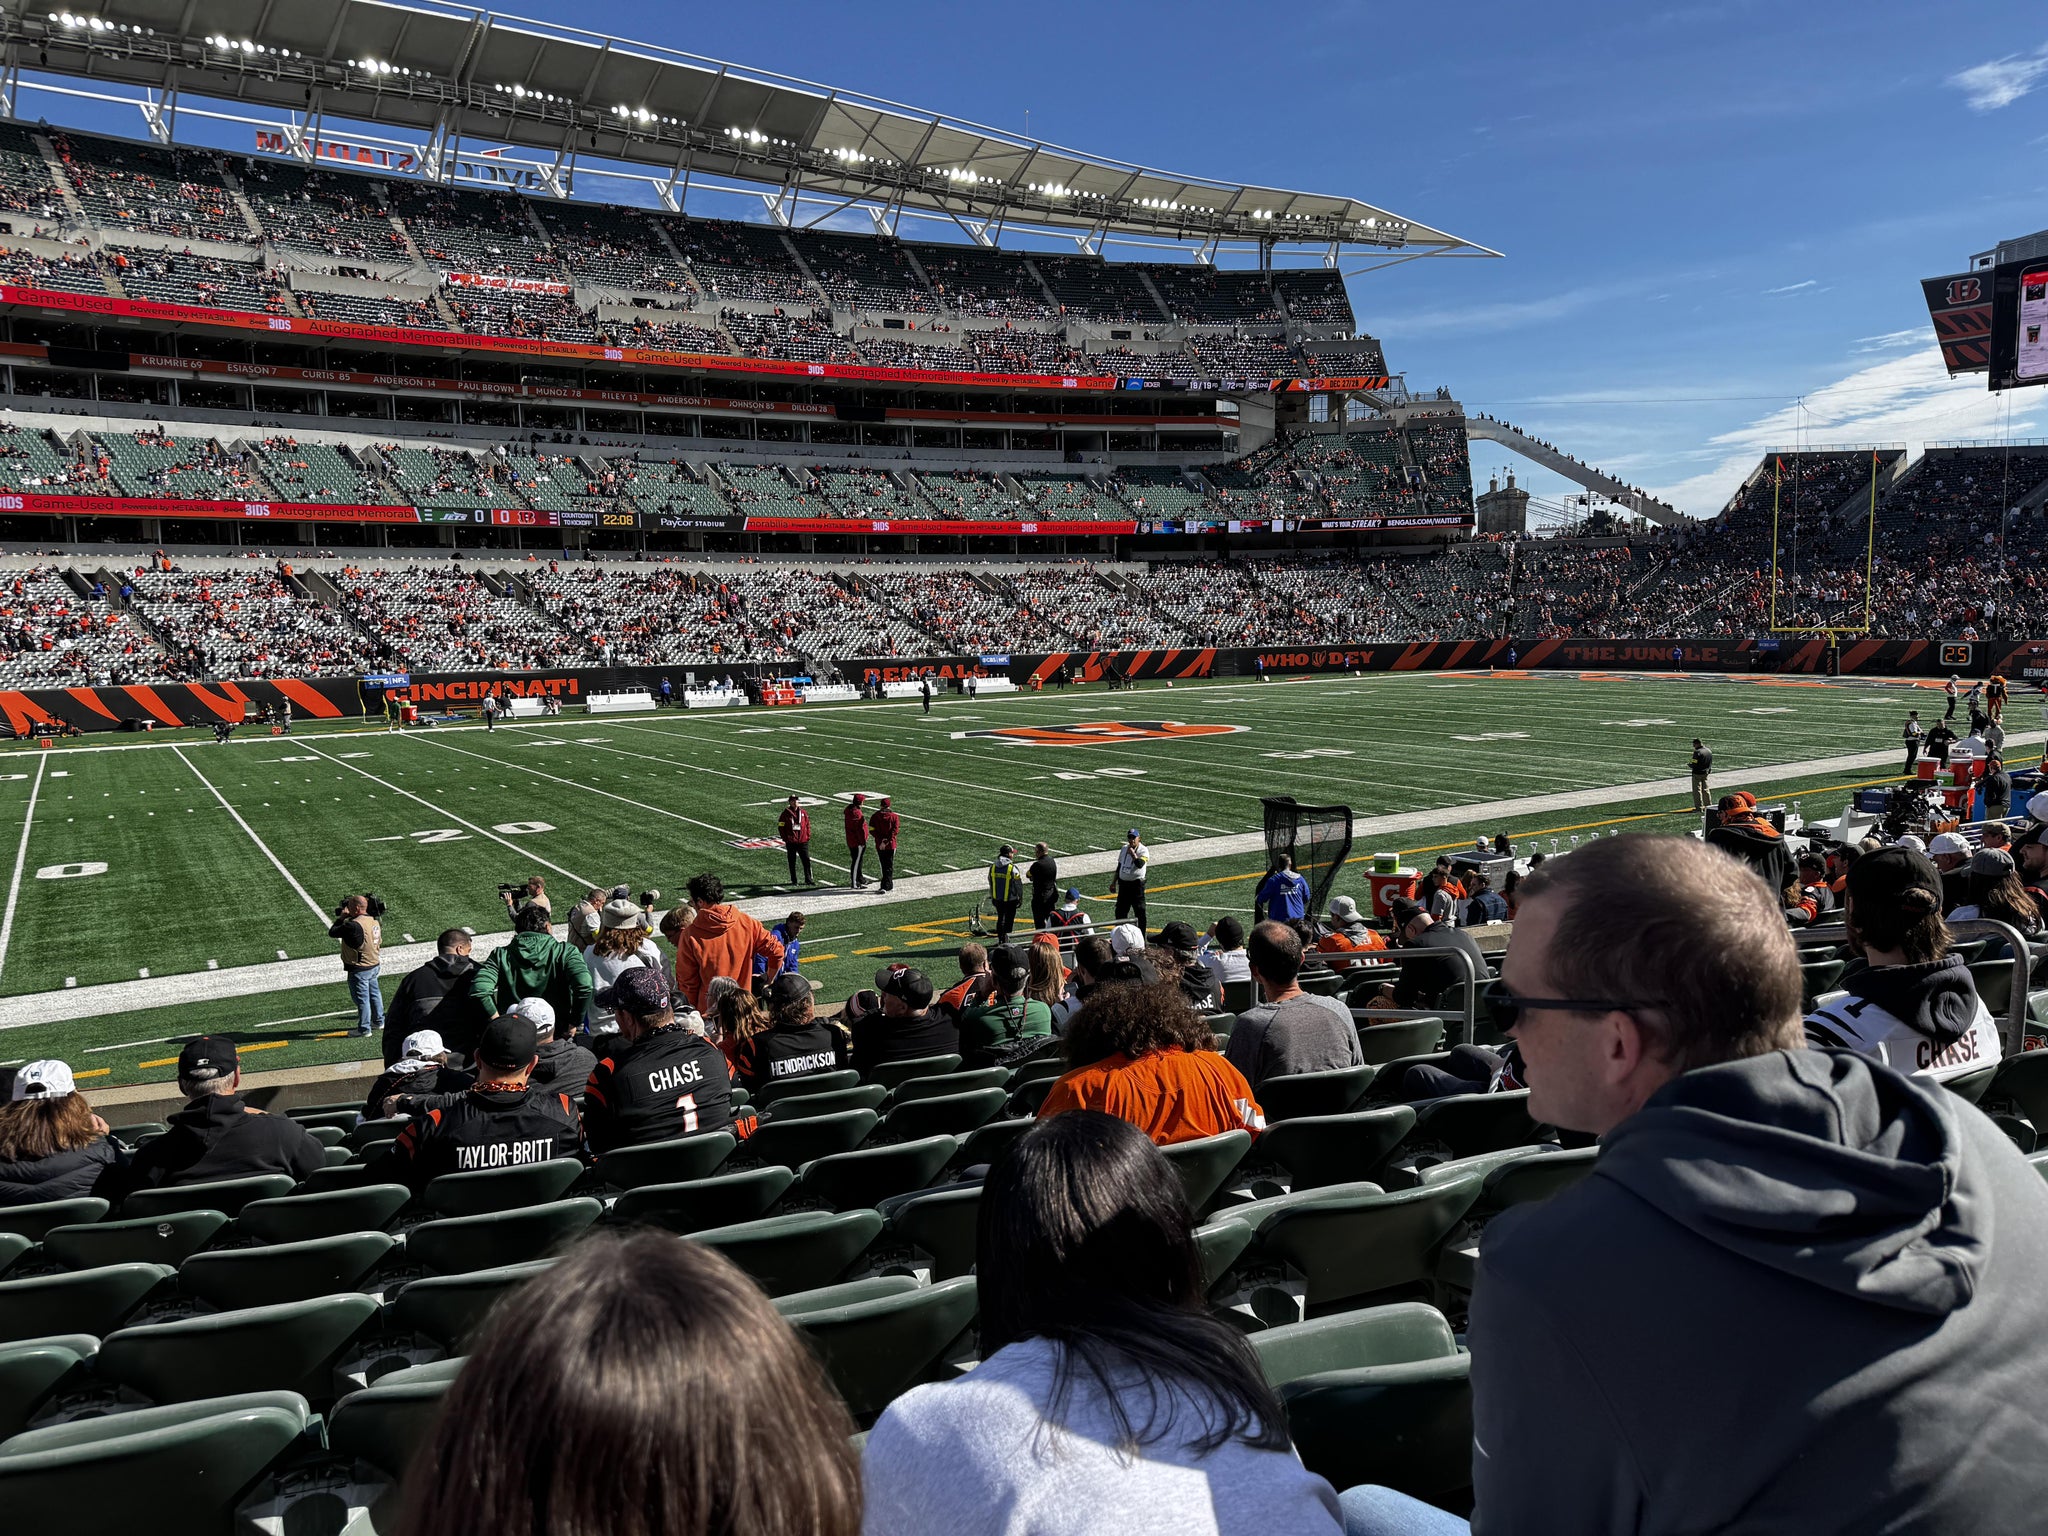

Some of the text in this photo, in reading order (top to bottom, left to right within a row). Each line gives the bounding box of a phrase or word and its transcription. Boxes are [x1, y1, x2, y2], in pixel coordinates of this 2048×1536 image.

[16, 290, 113, 311] Game-Used
[130, 305, 175, 317] Powered
[177, 309, 189, 319] by
[269, 318, 292, 330] BIDS
[309, 322, 482, 347] Autographed Memorabilia
[493, 341, 528, 350] Powered
[530, 344, 540, 353] by
[141, 356, 203, 369] KRUMRIE 69
[636, 352, 702, 365] Game-Used
[710, 359, 742, 367] Powered
[227, 363, 277, 375] ESIASON 7
[834, 366, 963, 382] Autographed Memorabilia
[302, 370, 351, 381] CURTIS 85
[373, 375, 436, 387] ANDERSON 14
[458, 382, 515, 393] PAUL BROWN
[535, 387, 568, 397] MUNOZ
[601, 392, 626, 400] RILEY
[657, 396, 700, 405] ANDERSON
[729, 401, 765, 410] JOHNSON
[791, 404, 818, 412] DILLON
[0, 496, 114, 511] IDS Game-Used
[122, 503, 158, 511] Powered
[159, 504, 169, 512] by
[245, 504, 270, 516] BIDS
[276, 507, 354, 518] Autographed
[474, 510, 485, 522] 0
[500, 510, 510, 523] 0
[603, 514, 634, 526] 22:08
[660, 516, 693, 529] Paycor
[1351, 519, 1382, 528] STREAK?
[1387, 517, 1462, 527] BENGALS.COM/WAITLIST
[1563, 647, 1615, 661] THE
[1945, 646, 1967, 662] 25
[1260, 653, 1309, 668] WHO
[410, 821, 557, 844] 20
[1916, 1029, 1980, 1070] CHASE
[770, 1050, 836, 1077] HENDRICKSON
[648, 1060, 703, 1094] CHASE
[675, 1093, 698, 1132] 1
[456, 1138, 553, 1169] TAYLOR-BRITT
